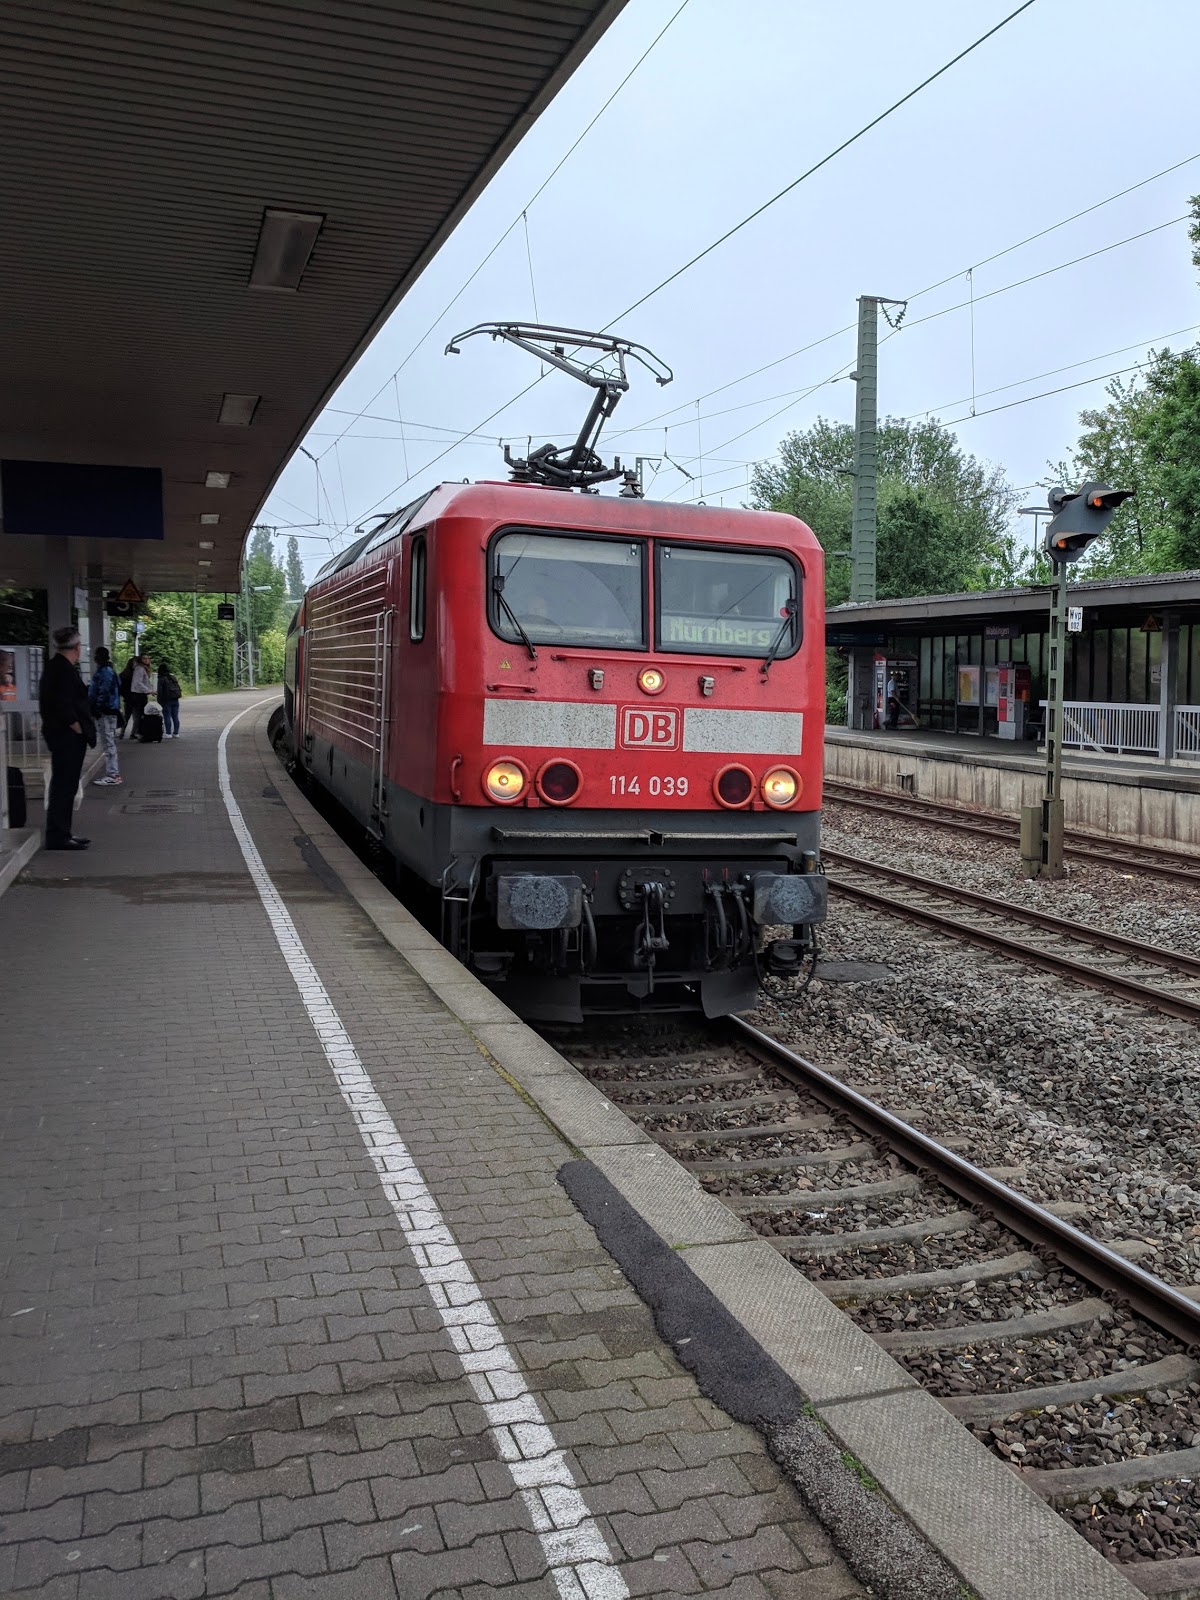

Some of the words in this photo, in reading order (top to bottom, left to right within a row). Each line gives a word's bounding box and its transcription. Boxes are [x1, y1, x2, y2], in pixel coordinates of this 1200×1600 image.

[670, 617, 771, 647] Nürnberg
[628, 713, 672, 742] DB
[610, 775, 641, 795] 114
[649, 776, 689, 796] 039
